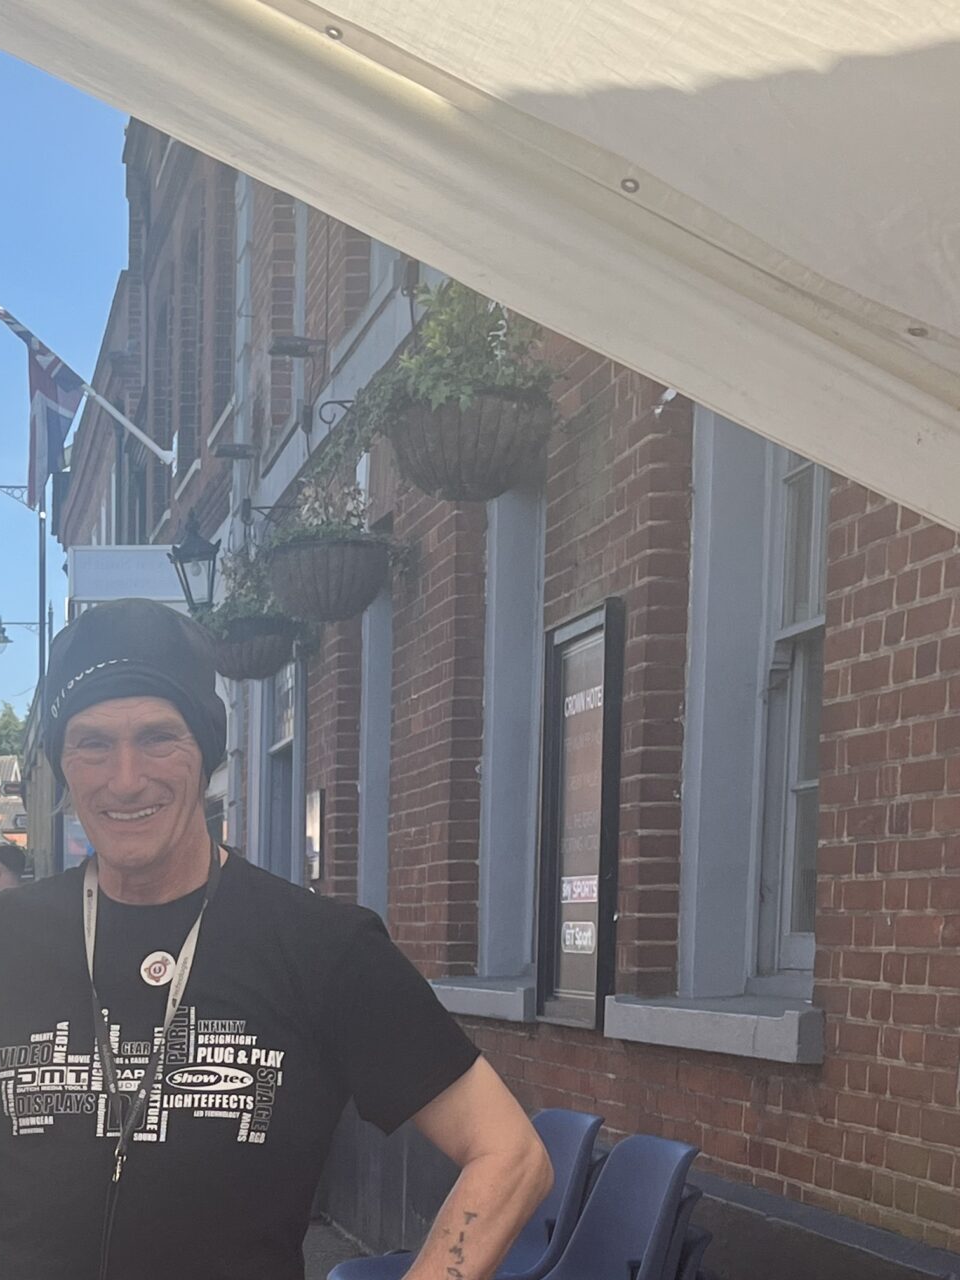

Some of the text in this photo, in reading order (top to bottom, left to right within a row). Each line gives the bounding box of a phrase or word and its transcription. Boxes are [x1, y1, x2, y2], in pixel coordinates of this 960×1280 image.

[564, 685, 604, 718] CROWN HOTE
[572, 880, 597, 899] SPORTS
[575, 928, 592, 949] Sport
[166, 1006, 188, 1065] PARTY
[198, 1020, 246, 1033] INFINITY
[31, 1032, 54, 1043] CREATE
[53, 1022, 70, 1064] MEDIA
[198, 1035, 258, 1046] DESIGNLIGHT
[122, 1042, 151, 1055] GEAR
[197, 1047, 284, 1068] PLUG & PLAY
[68, 1055, 90, 1063] MOVIE
[16, 1093, 96, 1116] DISPLAYS
[146, 1083, 162, 1131] FIXTURE
[163, 1094, 254, 1110] LIGHTEFFECTS
[251, 1068, 276, 1131] STAGE
[237, 1112, 252, 1142] SHOW
[133, 1133, 157, 1142] SOUND
[248, 1131, 266, 1144] RGB
